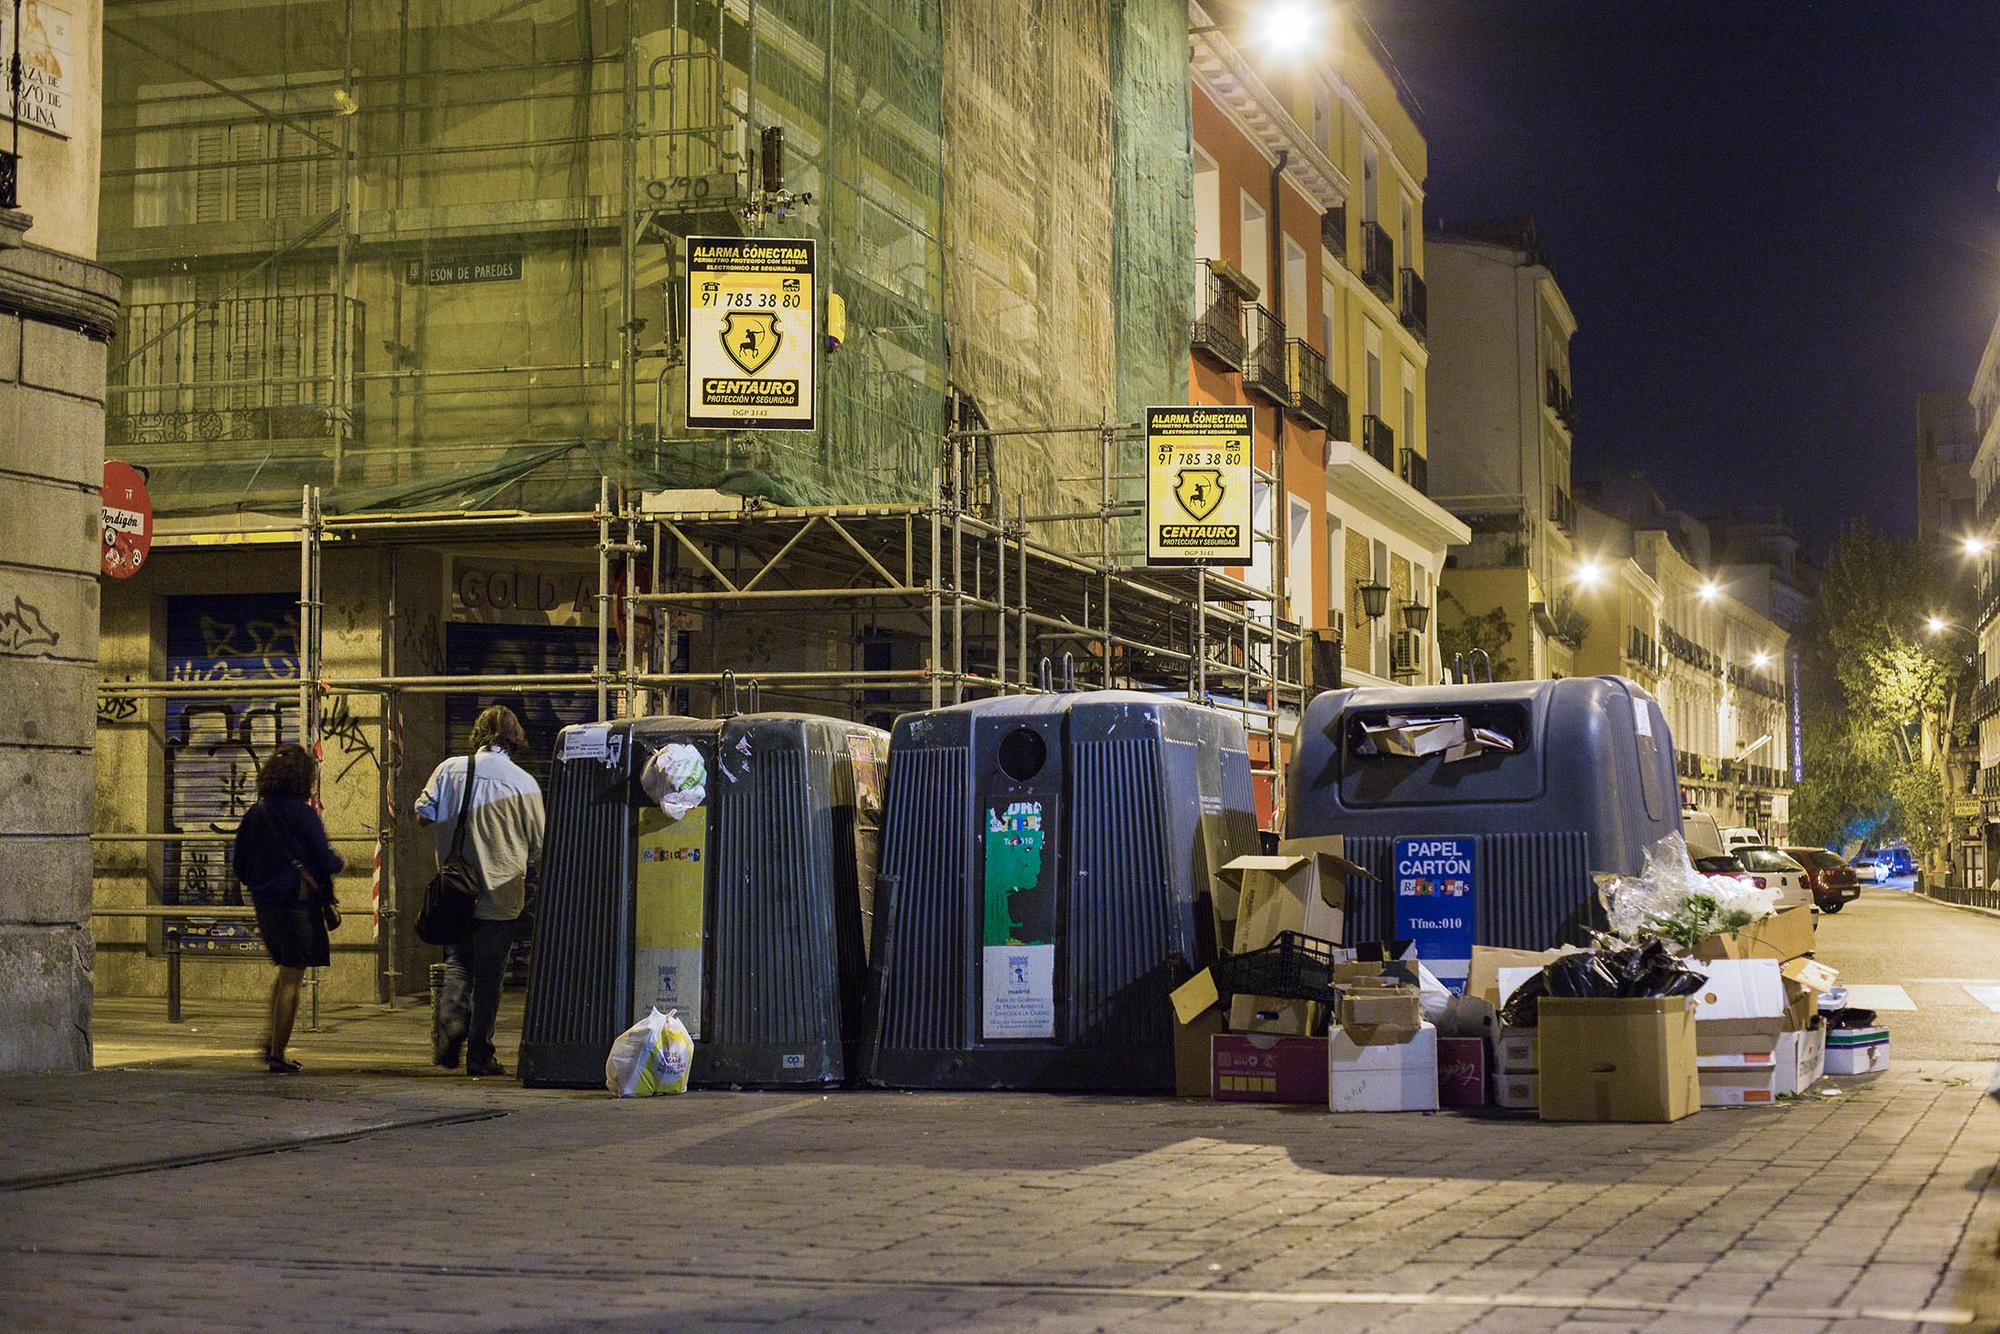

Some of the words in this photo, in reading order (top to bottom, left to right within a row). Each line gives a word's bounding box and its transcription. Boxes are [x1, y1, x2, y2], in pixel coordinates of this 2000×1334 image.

[48, 75, 60, 88] DE
[49, 92, 62, 108] DE
[694, 246, 740, 258] ALARMA
[742, 247, 808, 259] CONECTADA
[457, 266, 470, 280] DE
[474, 263, 514, 278] PAREDES
[701, 292, 718, 306] 91
[726, 293, 753, 307] 785
[758, 293, 777, 307] 38
[782, 294, 801, 308] 80
[705, 380, 796, 395] CENTAURO
[706, 394, 749, 404] PROTECCIÓN
[756, 396, 795, 404] SEGURIDAD
[751, 409, 768, 417] 3143
[1151, 414, 1190, 424] ALARMA
[1192, 414, 1247, 424] CONECTADA
[1158, 453, 1172, 465] 91
[1179, 453, 1201, 465] 785
[1205, 453, 1221, 465] 38
[1225, 453, 1241, 465] 80
[1162, 526, 1238, 538] CENTAURO
[1162, 537, 1198, 546] PROTECCIÓN
[1199, 538, 1204, 546] Y
[1203, 538, 1236, 546] SEGURIDAD
[459, 569, 556, 611] GOLD
[1407, 841, 1463, 857] PAPEL
[1399, 857, 1472, 875] CARTÓN
[1408, 917, 1463, 929] Tfno.:010
